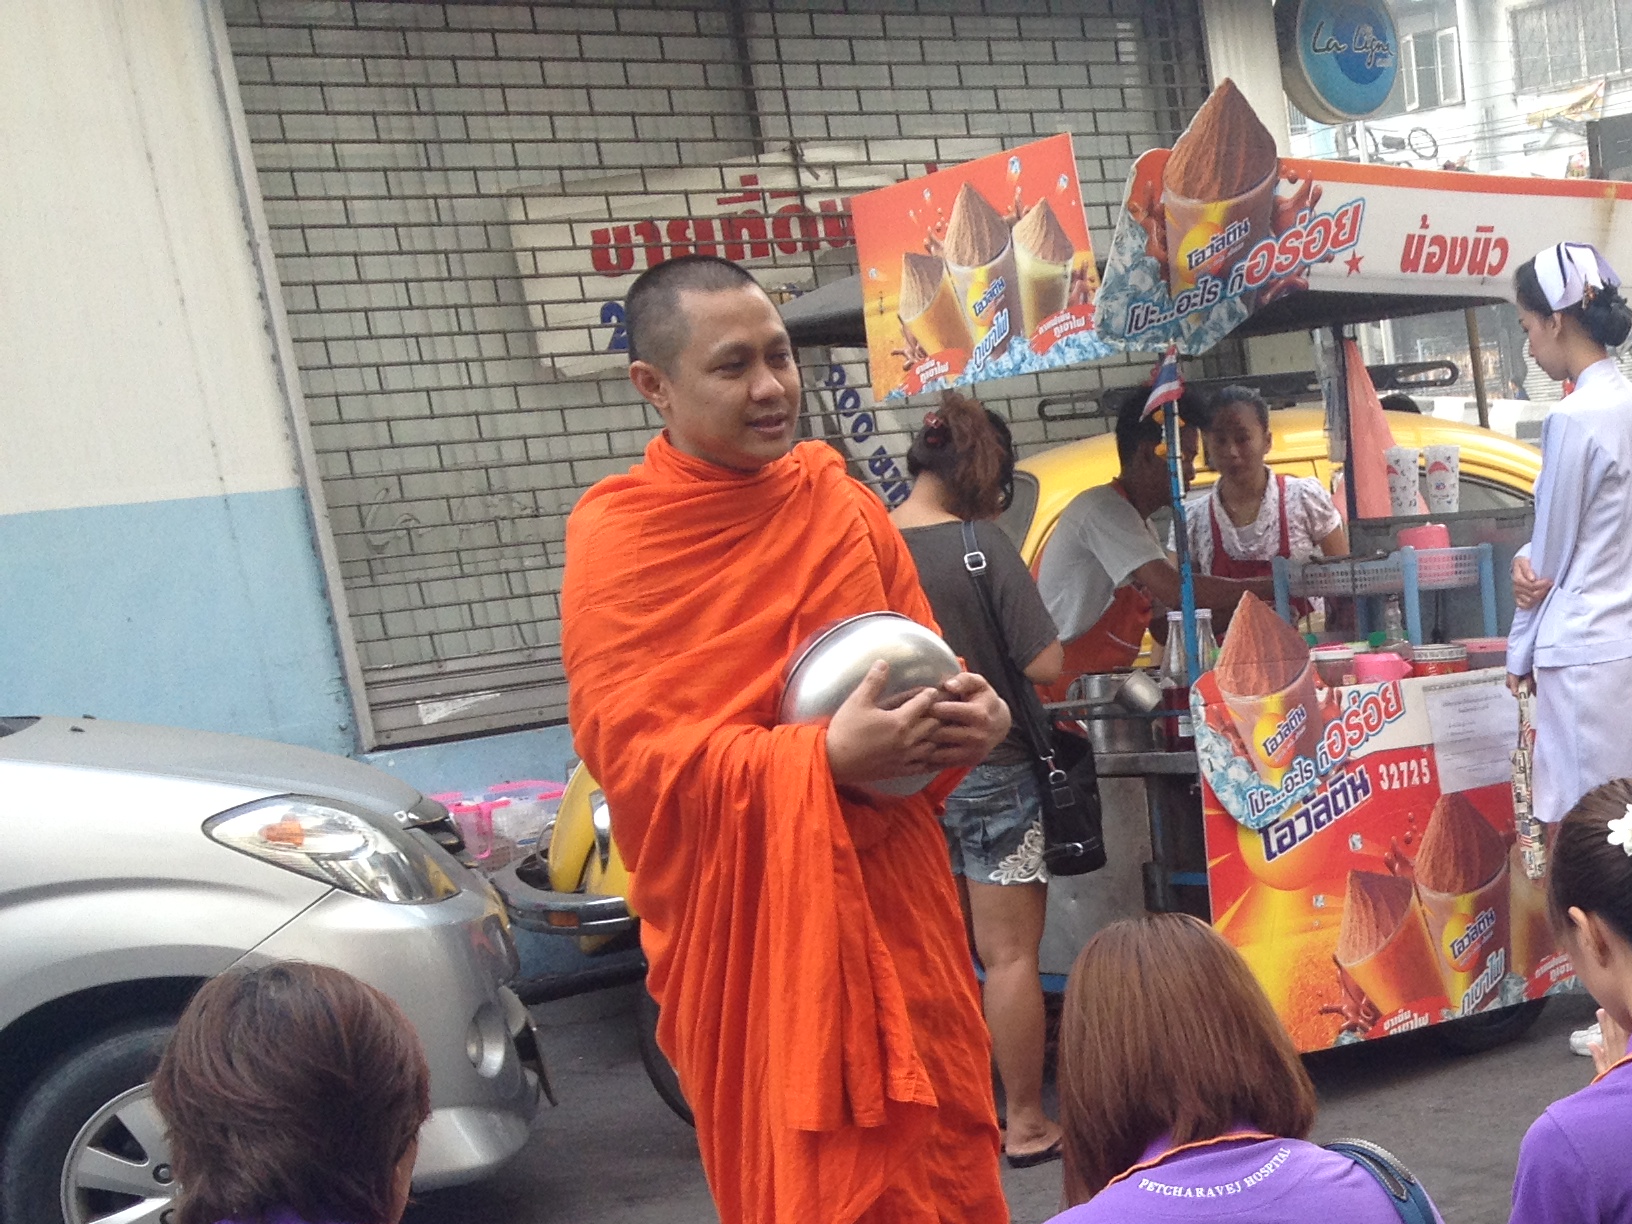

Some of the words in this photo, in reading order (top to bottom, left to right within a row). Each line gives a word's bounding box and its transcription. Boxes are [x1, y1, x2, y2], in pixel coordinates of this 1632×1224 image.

[1186, 217, 1250, 271] โอวัลติน
[1262, 704, 1306, 756] โอวัลติน
[1378, 758, 1431, 790] 32725
[1259, 764, 1373, 862] โอวัลติน
[1450, 907, 1496, 960] โอวัลติน
[1138, 1178, 1242, 1198] PETCHARAVEJ
[1243, 1147, 1291, 1188] HOSPITAL
